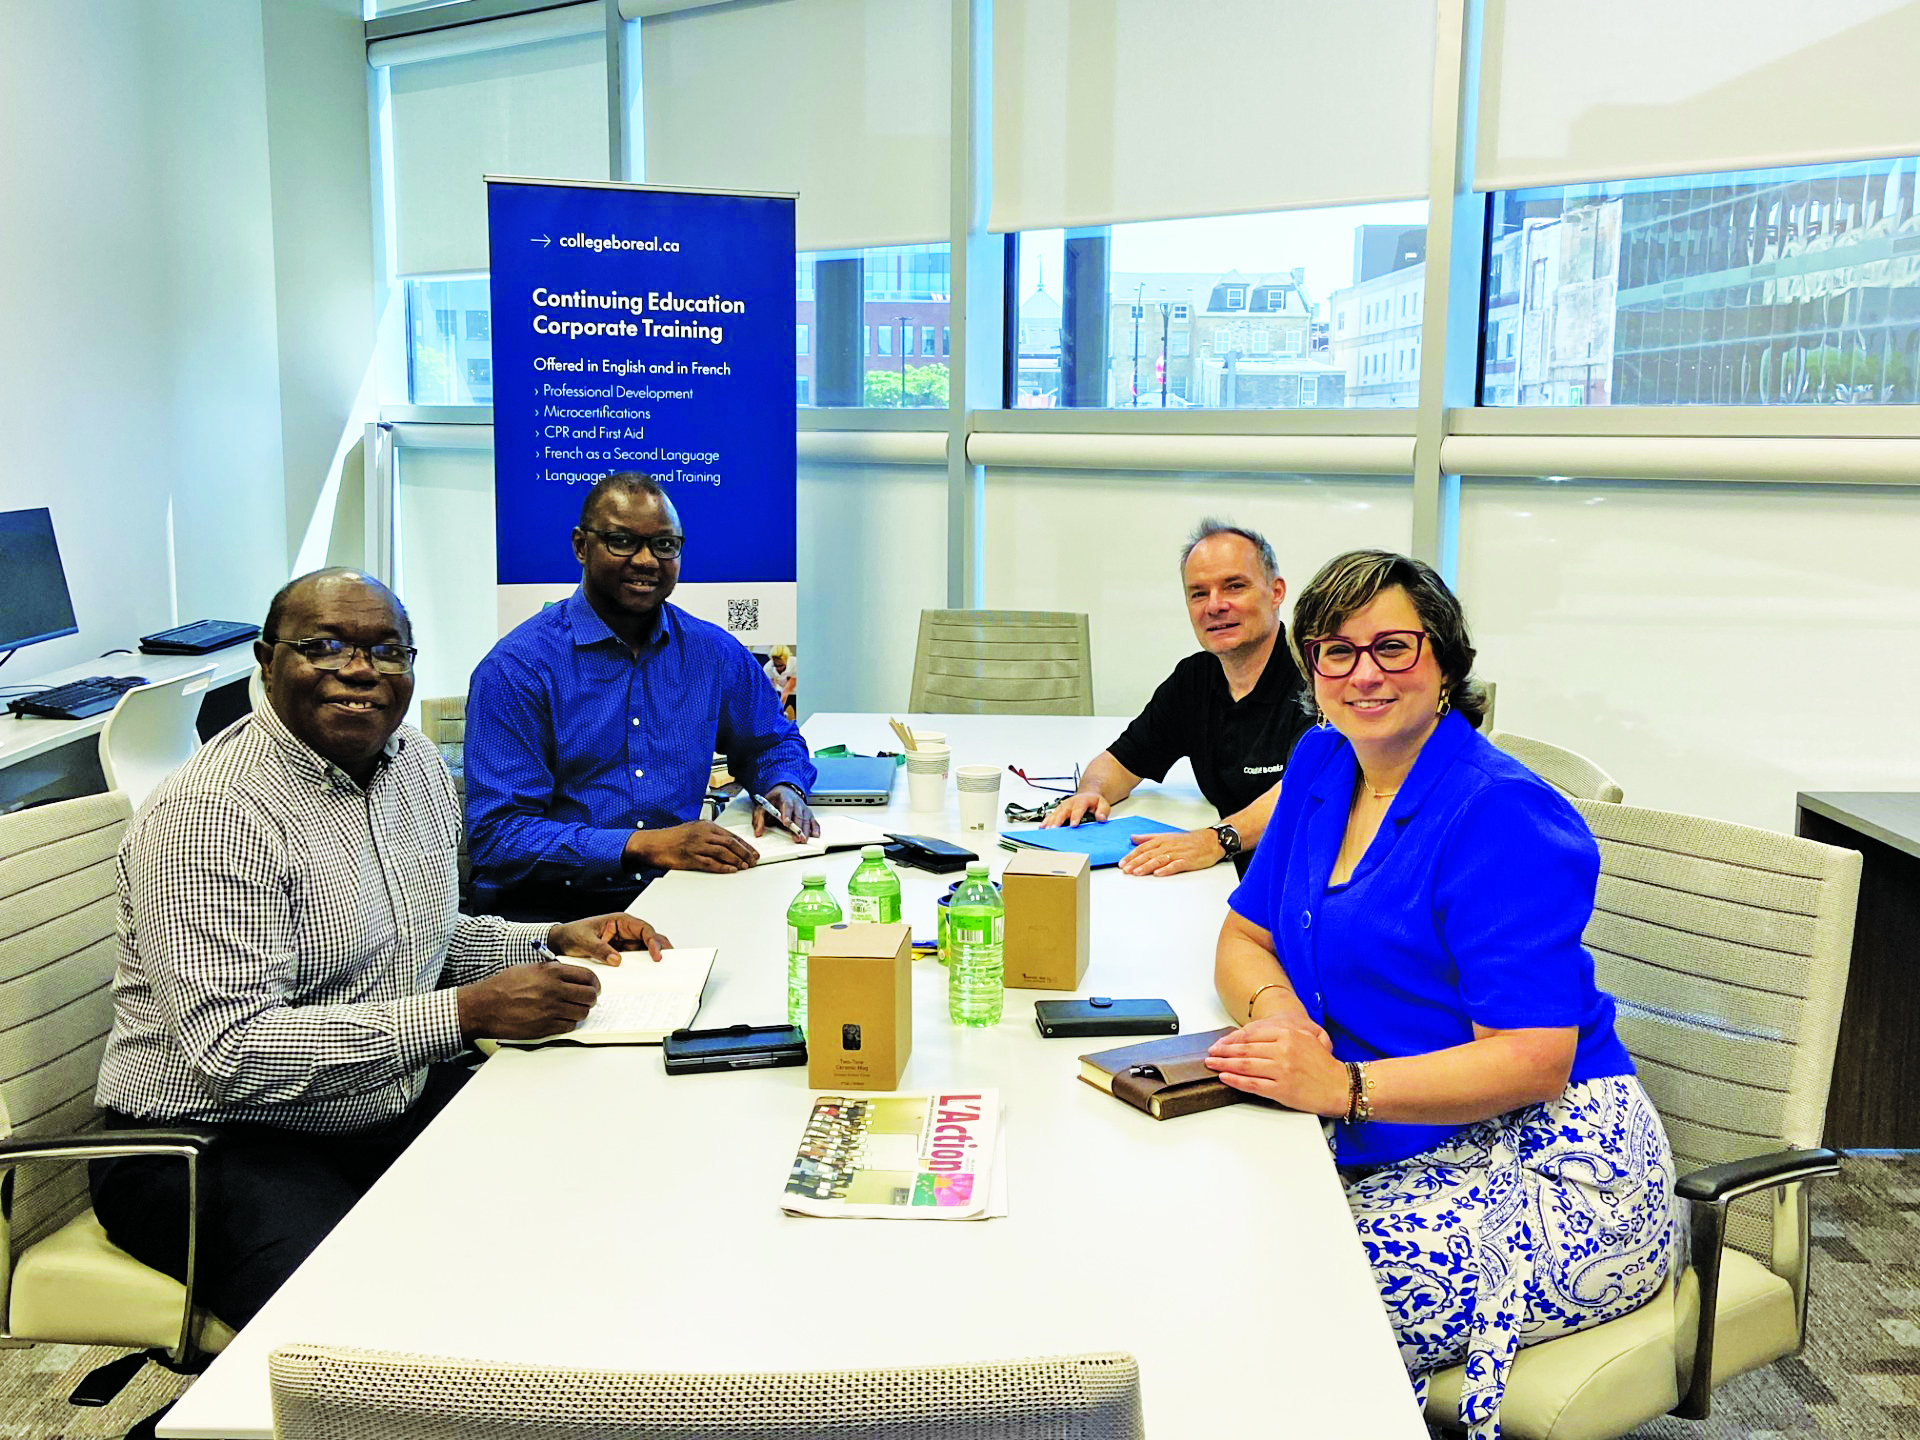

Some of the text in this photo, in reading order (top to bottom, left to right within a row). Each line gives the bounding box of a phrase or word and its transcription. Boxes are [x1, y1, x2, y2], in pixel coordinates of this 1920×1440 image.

[559, 232, 680, 253] collegeboreal.ca
[532, 288, 745, 315] Continuing Education
[532, 315, 723, 345] Corporate Training
[533, 356, 731, 377] Offered in English and in French
[543, 382, 694, 402] Professional Development
[543, 404, 651, 420] Microcertifications
[544, 425, 644, 440] CPR and First Aid
[545, 446, 720, 465] French as a Second Language
[545, 468, 607, 486] Language
[650, 469, 674, 482] and
[675, 469, 721, 487] Training
[928, 1095, 982, 1171] L'Action
